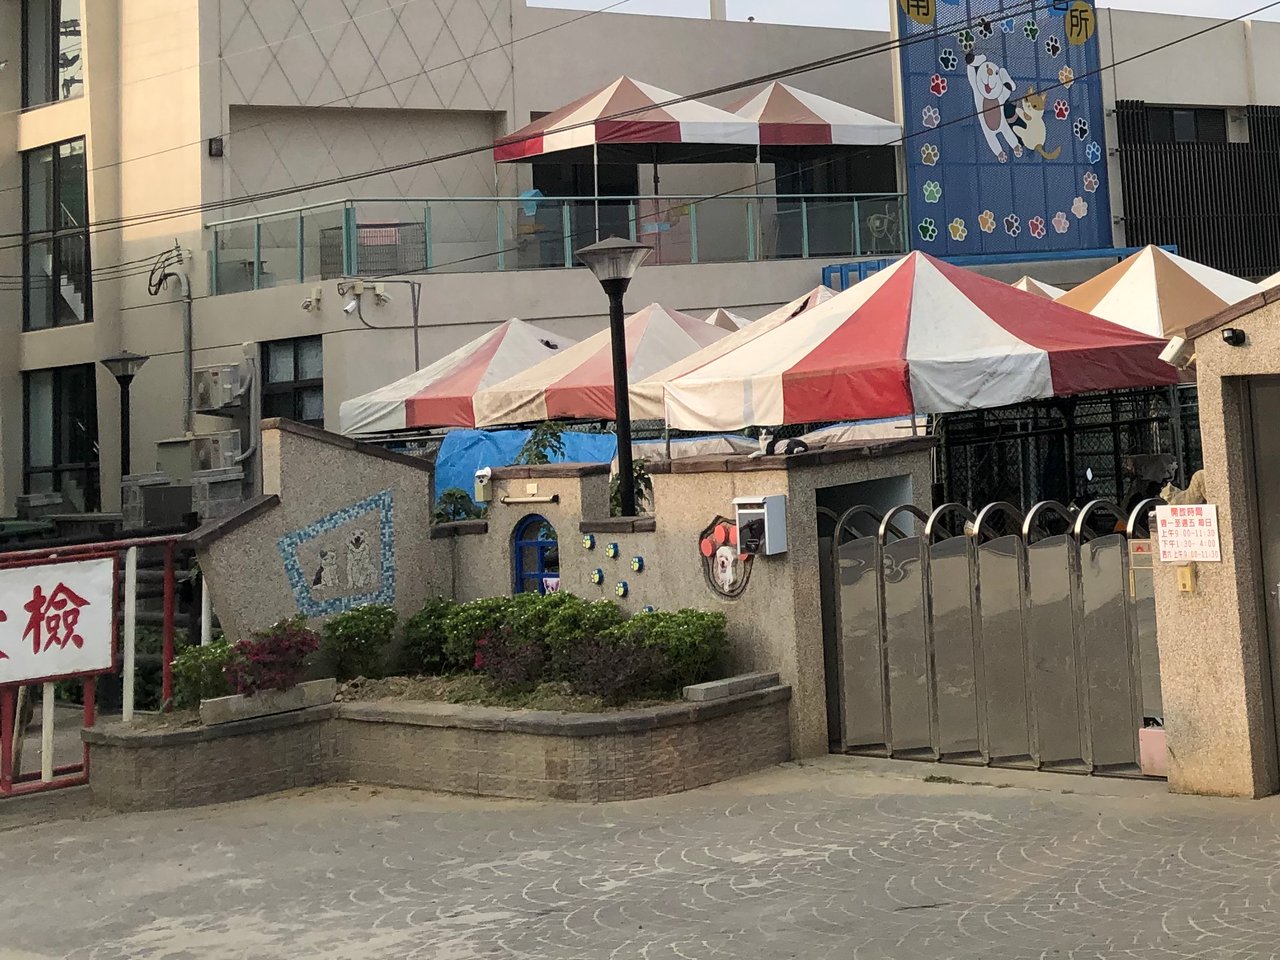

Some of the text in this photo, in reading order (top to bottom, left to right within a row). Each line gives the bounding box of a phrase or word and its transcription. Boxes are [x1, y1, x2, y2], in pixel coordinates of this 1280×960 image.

[1170, 507, 1203, 517] 開放時間
[0, 582, 91, 659] 檢
